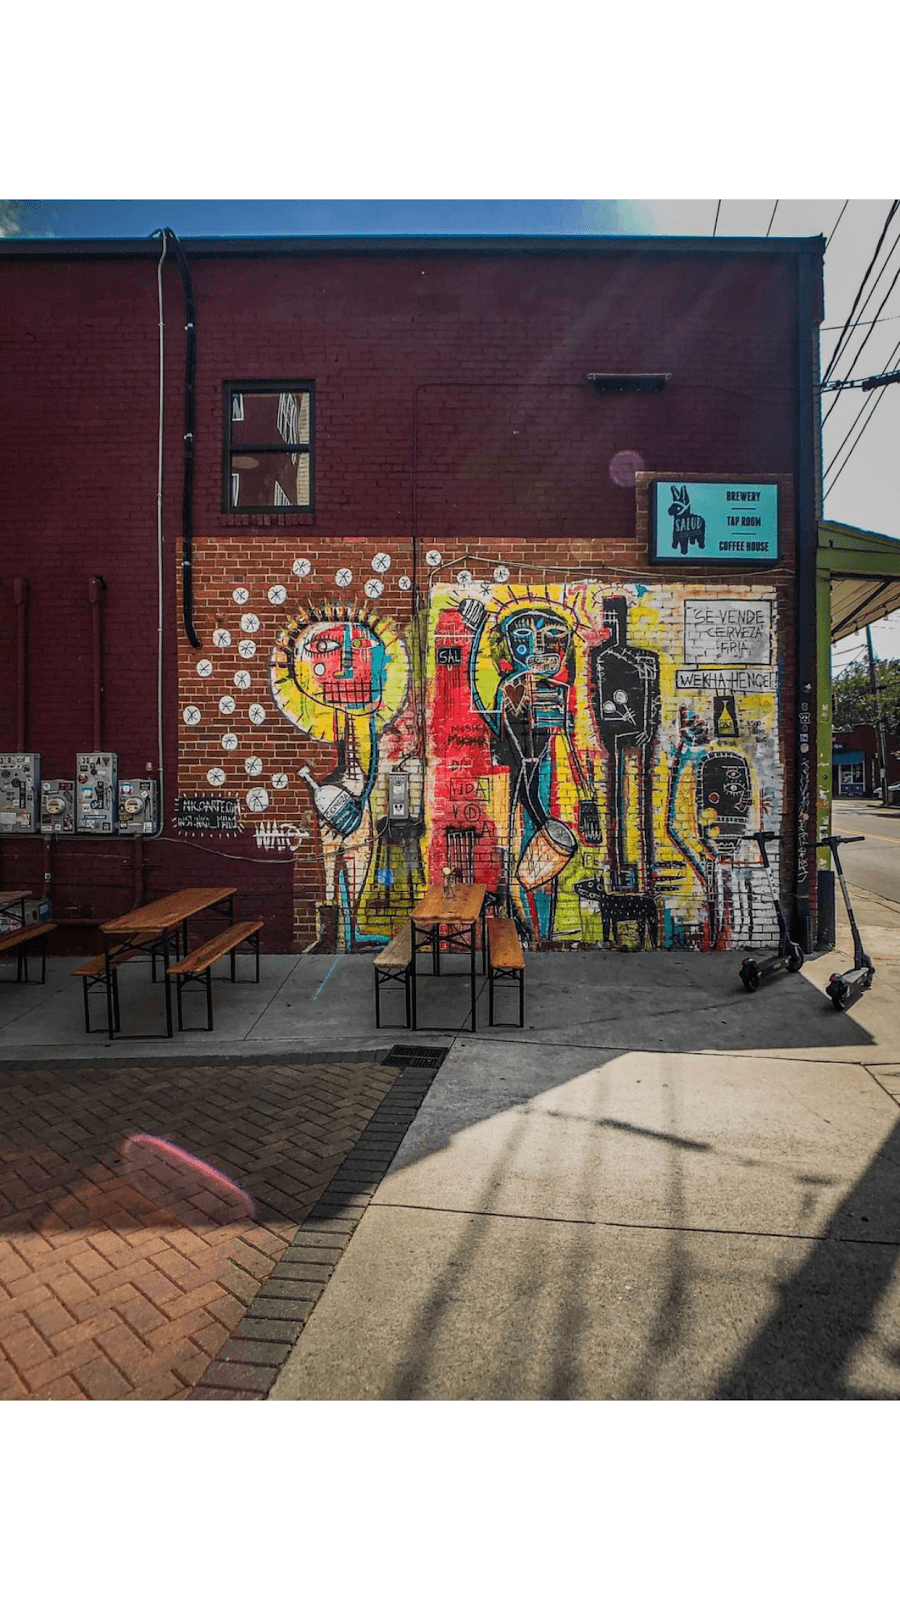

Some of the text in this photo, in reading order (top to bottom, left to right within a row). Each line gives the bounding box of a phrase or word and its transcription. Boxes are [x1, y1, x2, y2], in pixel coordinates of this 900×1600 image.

[726, 491, 761, 502] BREWERY
[675, 516, 703, 531] SALUD
[727, 516, 761, 527] TAP ROOM
[719, 541, 769, 552] COFFEE HOUSE
[719, 610, 765, 625] VENDE
[706, 626, 762, 639] CERVEZA
[439, 649, 460, 664] SAL
